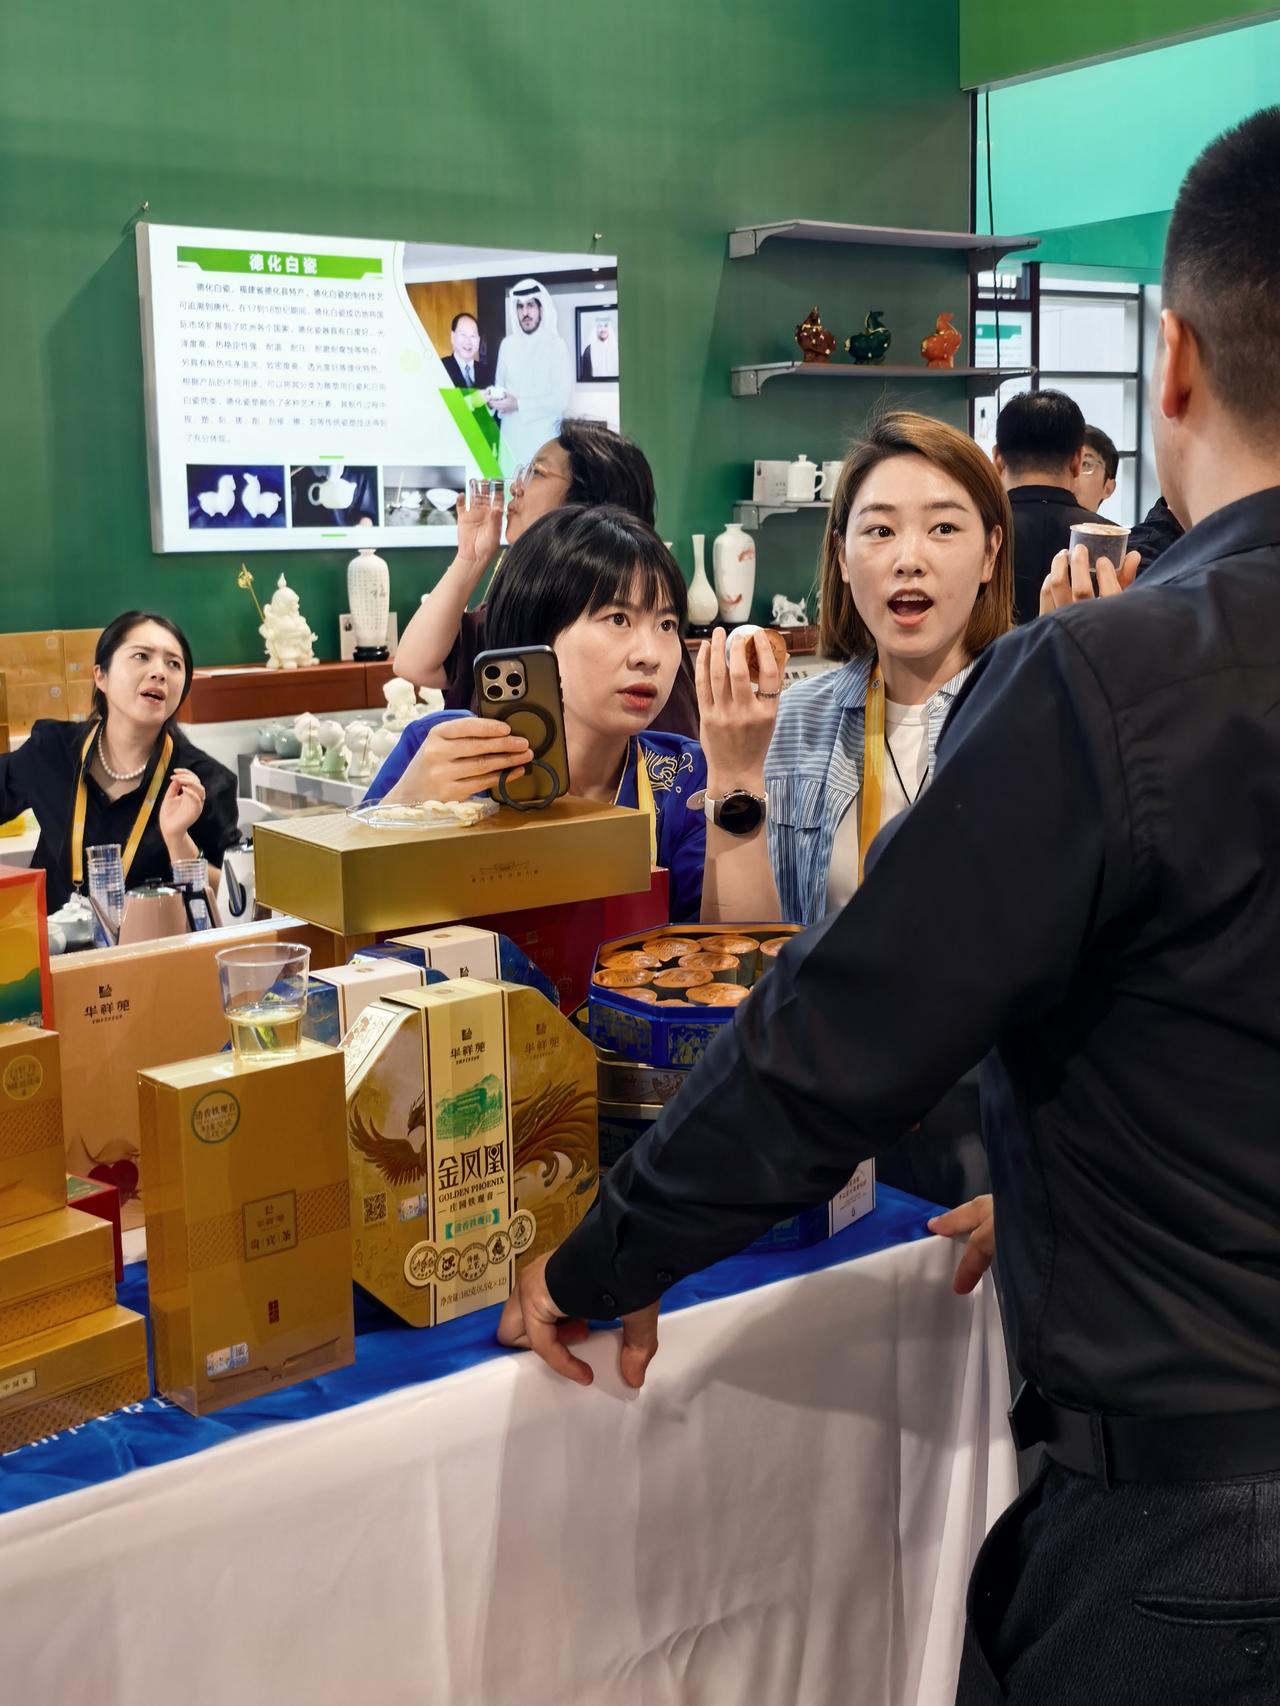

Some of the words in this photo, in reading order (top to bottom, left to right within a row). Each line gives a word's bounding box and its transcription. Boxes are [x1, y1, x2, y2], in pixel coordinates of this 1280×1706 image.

[249, 253, 318, 275] 德化白瓷
[84, 999, 130, 1018] 华祥苑
[450, 1041, 486, 1059] 华祥苑
[438, 1140, 506, 1192] 金凤凰
[438, 1187, 470, 1203] GOLDEN
[471, 1176, 505, 1193] PHOENIX
[449, 1191, 494, 1213] 庄园铁观音
